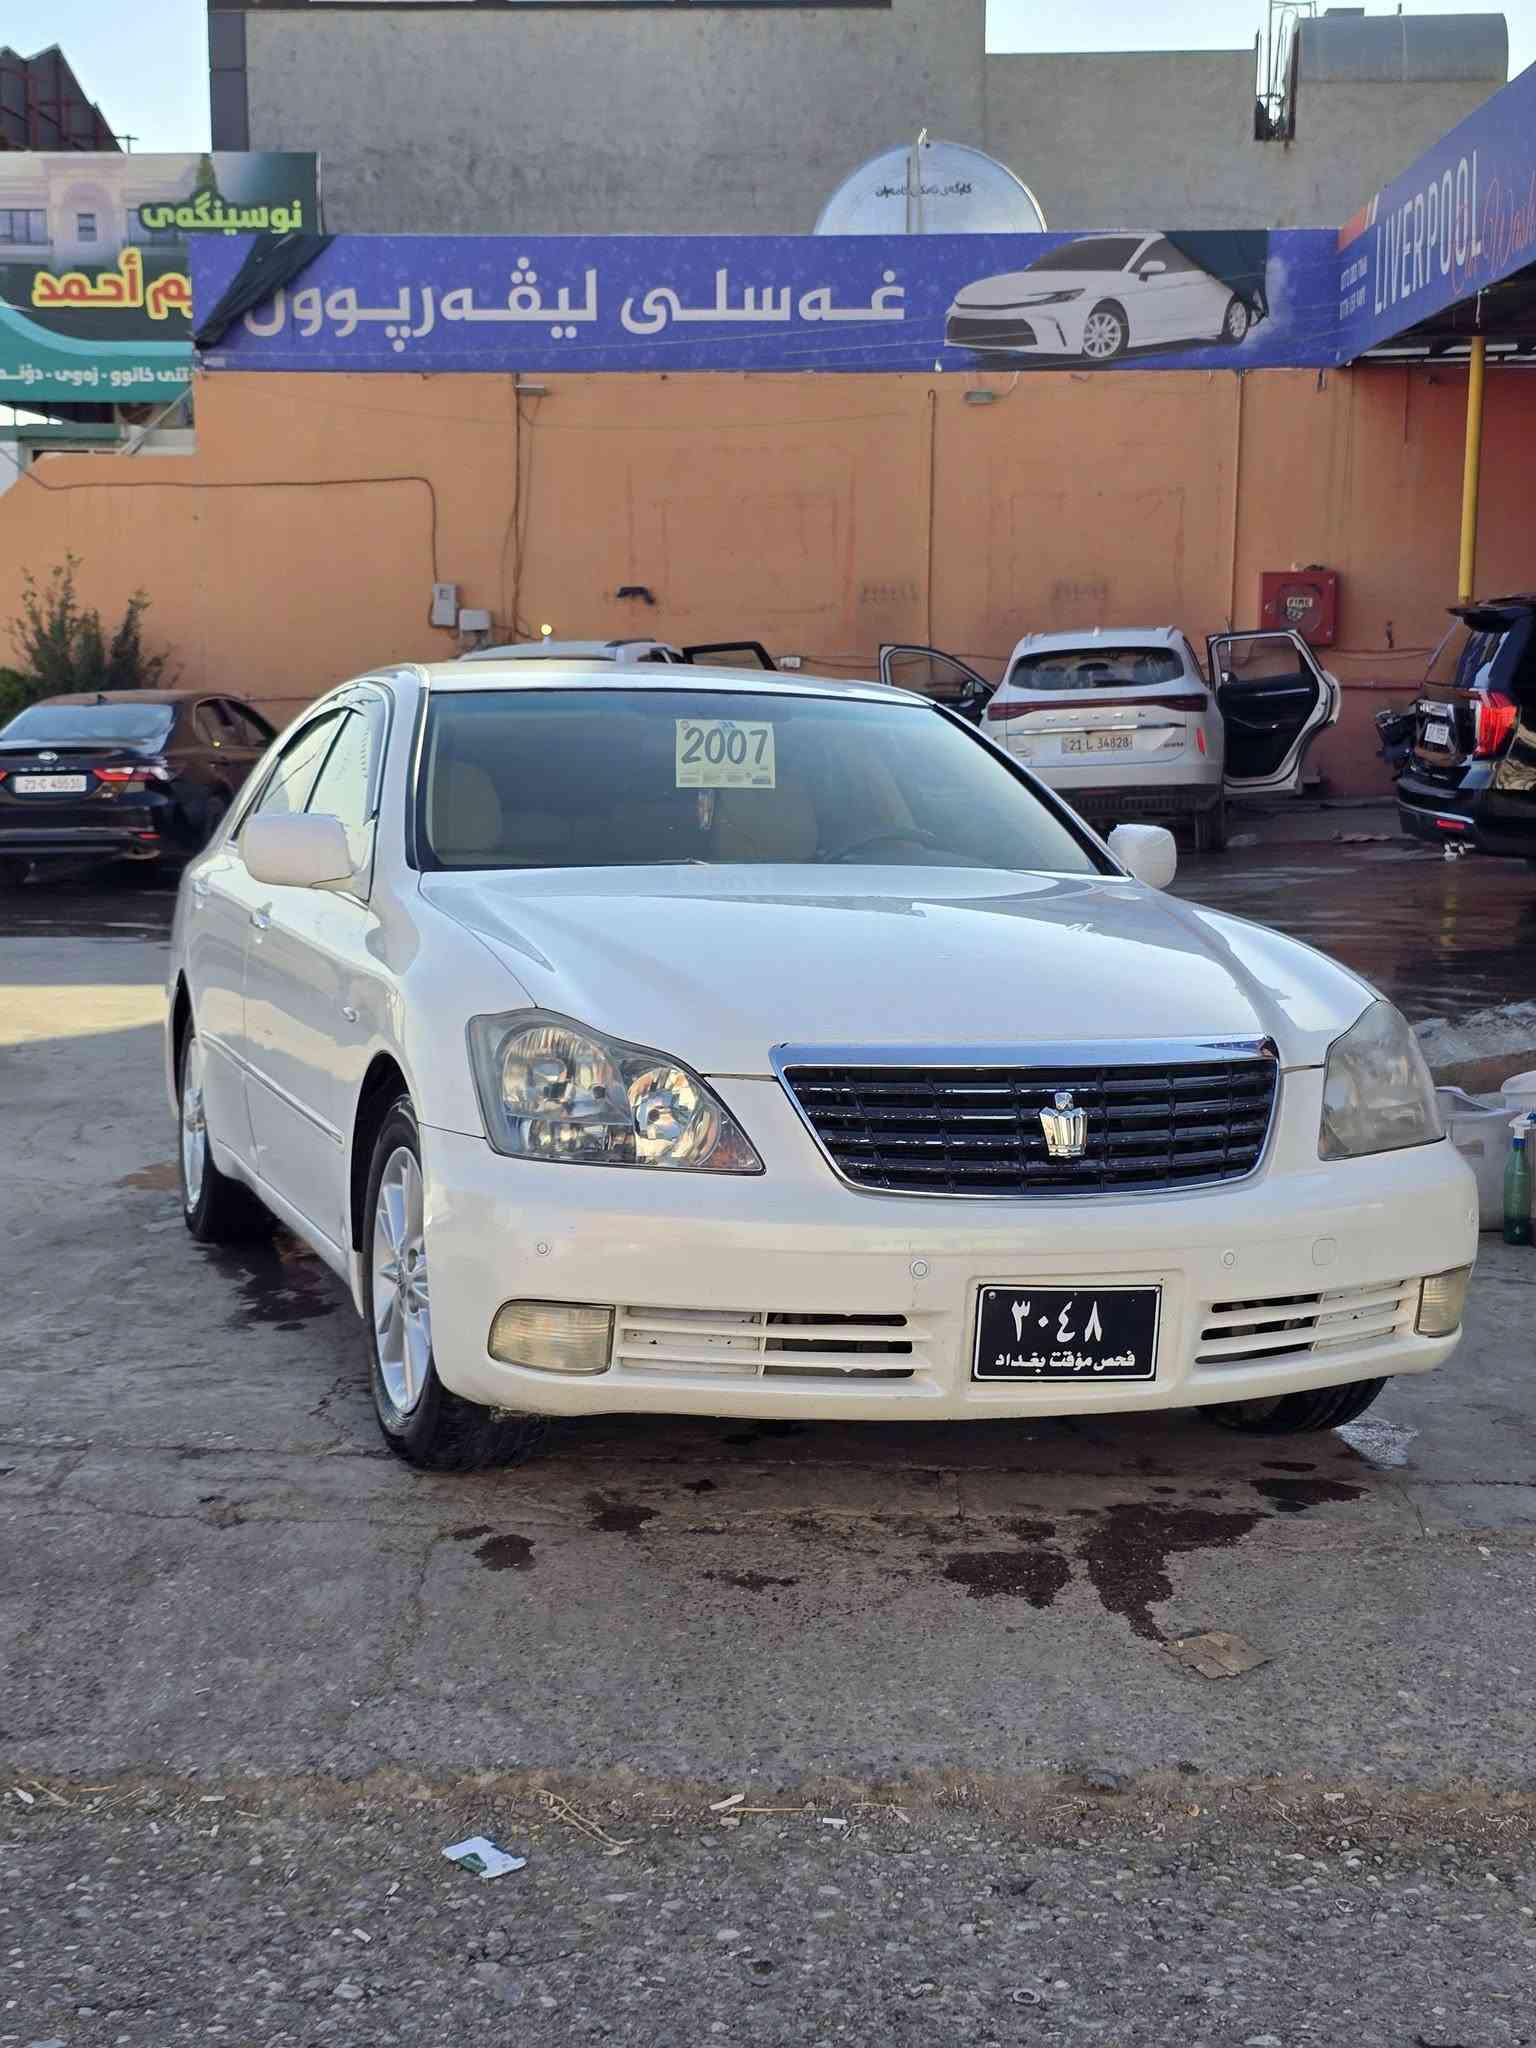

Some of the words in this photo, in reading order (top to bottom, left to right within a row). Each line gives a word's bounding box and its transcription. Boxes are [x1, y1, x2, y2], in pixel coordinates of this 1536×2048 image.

[1374, 150, 1481, 316] LIVERPOOL
[33, 247, 144, 307] أحمد
[682, 727, 768, 764] 2007
[1011, 1300, 1103, 1343] ٣٠٤٨
[995, 1351, 1047, 1374] بغداد
[1093, 1350, 1136, 1371] فحص
